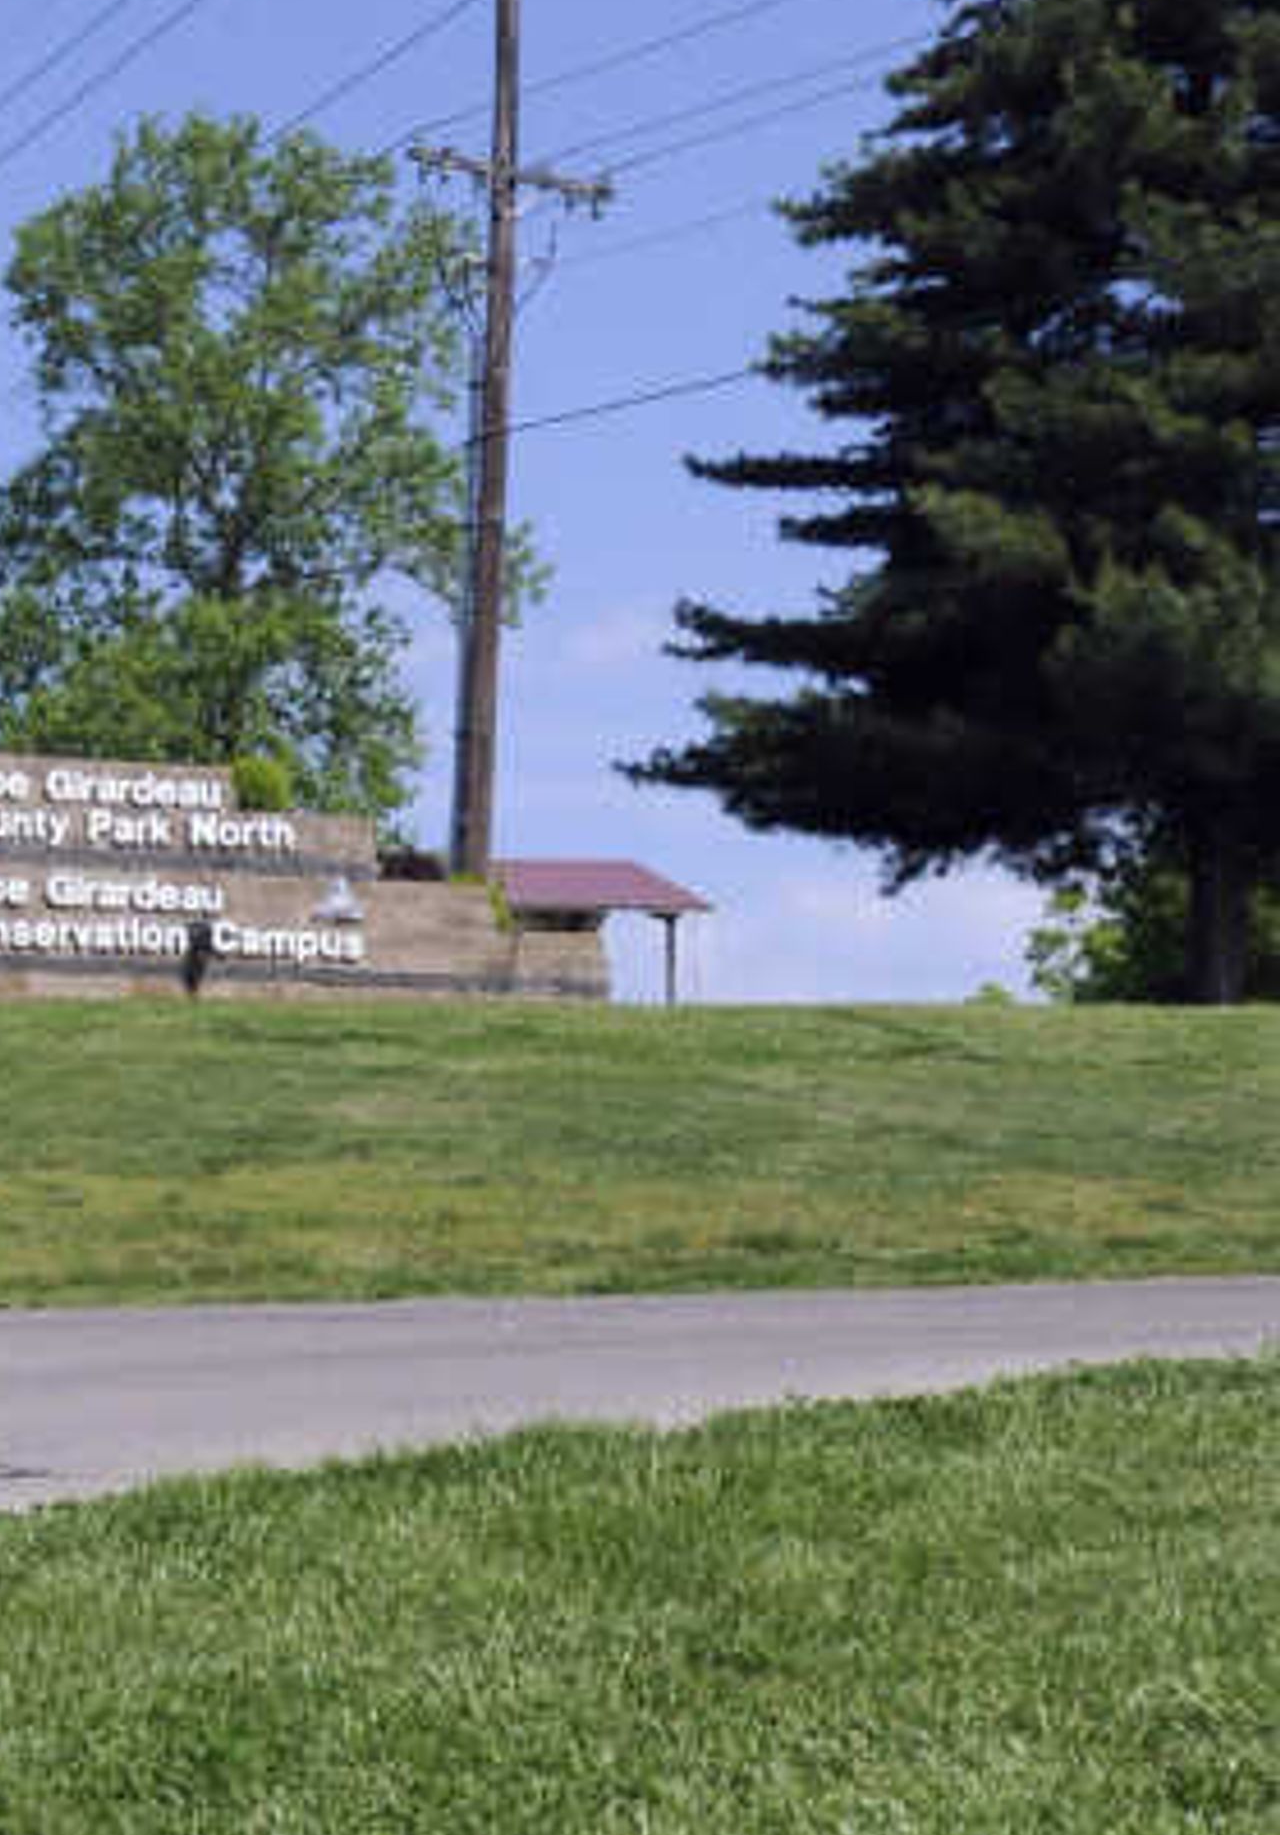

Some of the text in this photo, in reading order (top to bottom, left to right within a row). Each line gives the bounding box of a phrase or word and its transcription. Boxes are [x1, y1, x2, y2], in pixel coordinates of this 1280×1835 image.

[46, 769, 223, 809] Girardeau
[87, 810, 172, 845] Park
[191, 813, 295, 848] North
[46, 873, 223, 912] Girardeau
[212, 922, 365, 962] Campus
